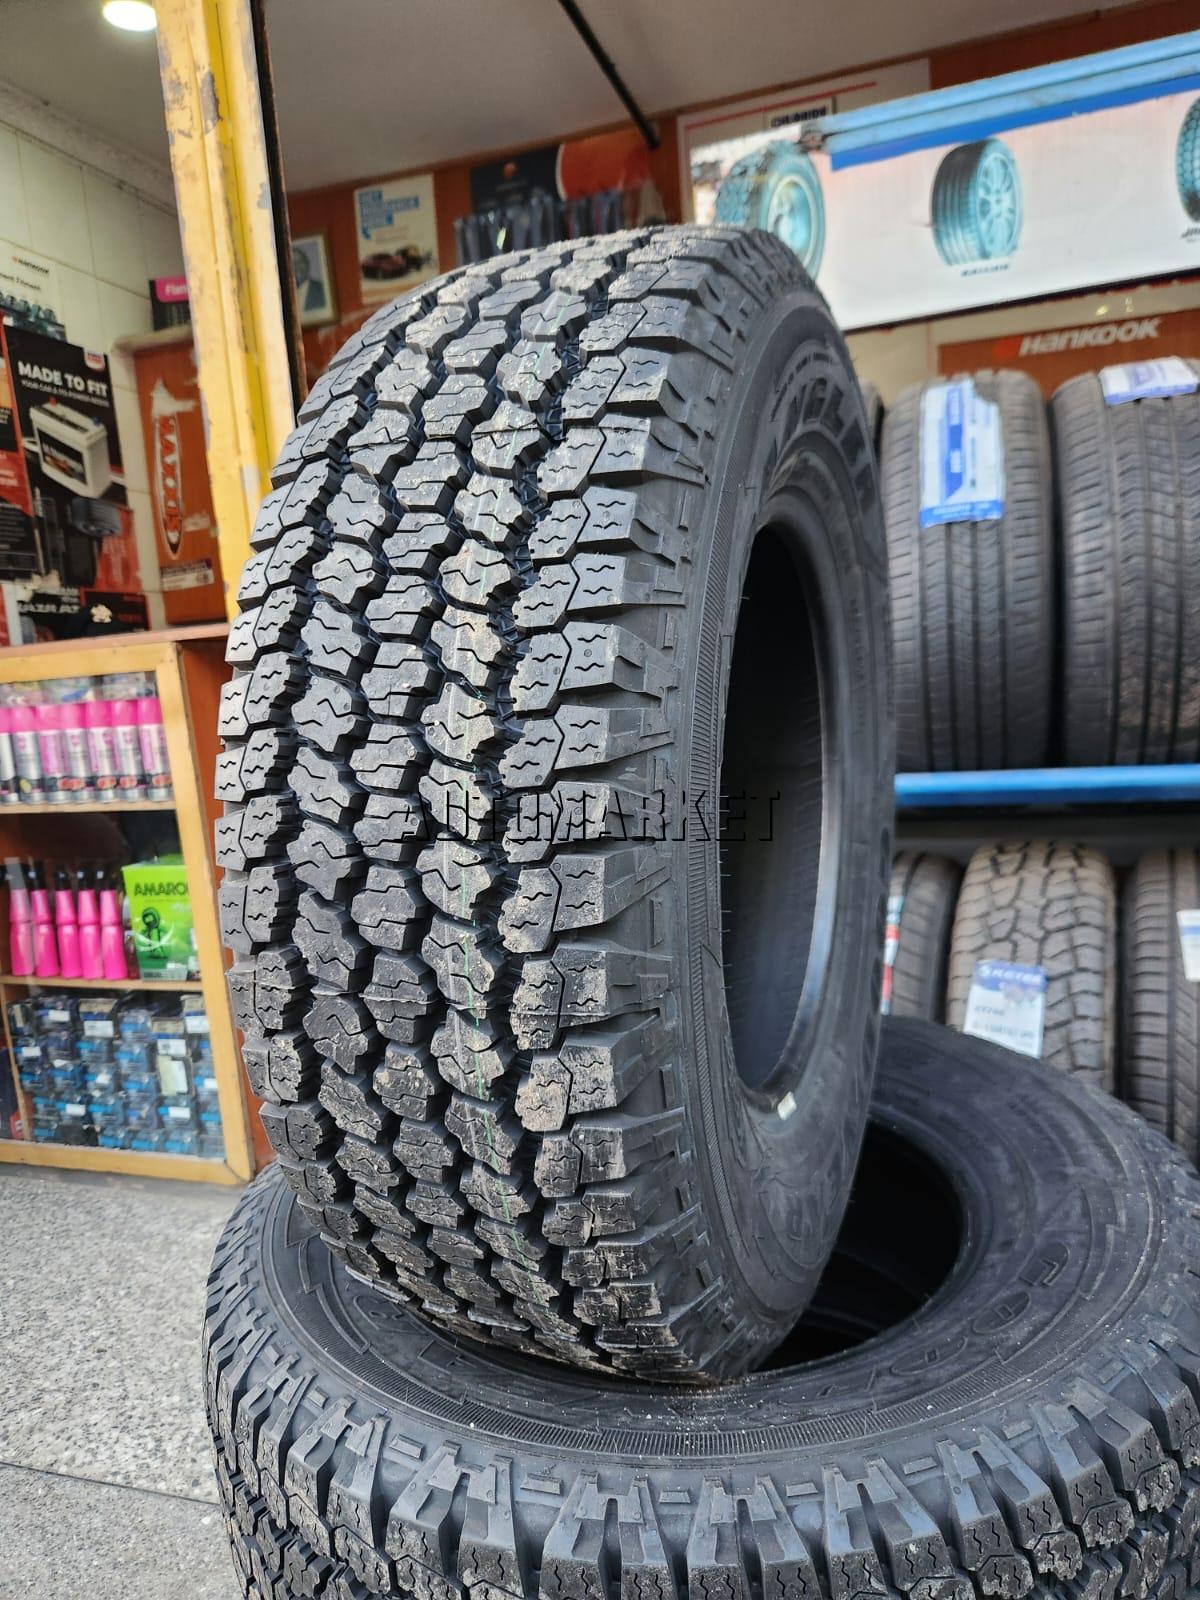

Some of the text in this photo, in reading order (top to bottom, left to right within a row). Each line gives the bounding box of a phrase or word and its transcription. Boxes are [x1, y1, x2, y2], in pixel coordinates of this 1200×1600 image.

[18, 361, 63, 386] MADE
[64, 373, 85, 391] TO
[87, 379, 107, 398] FIT
